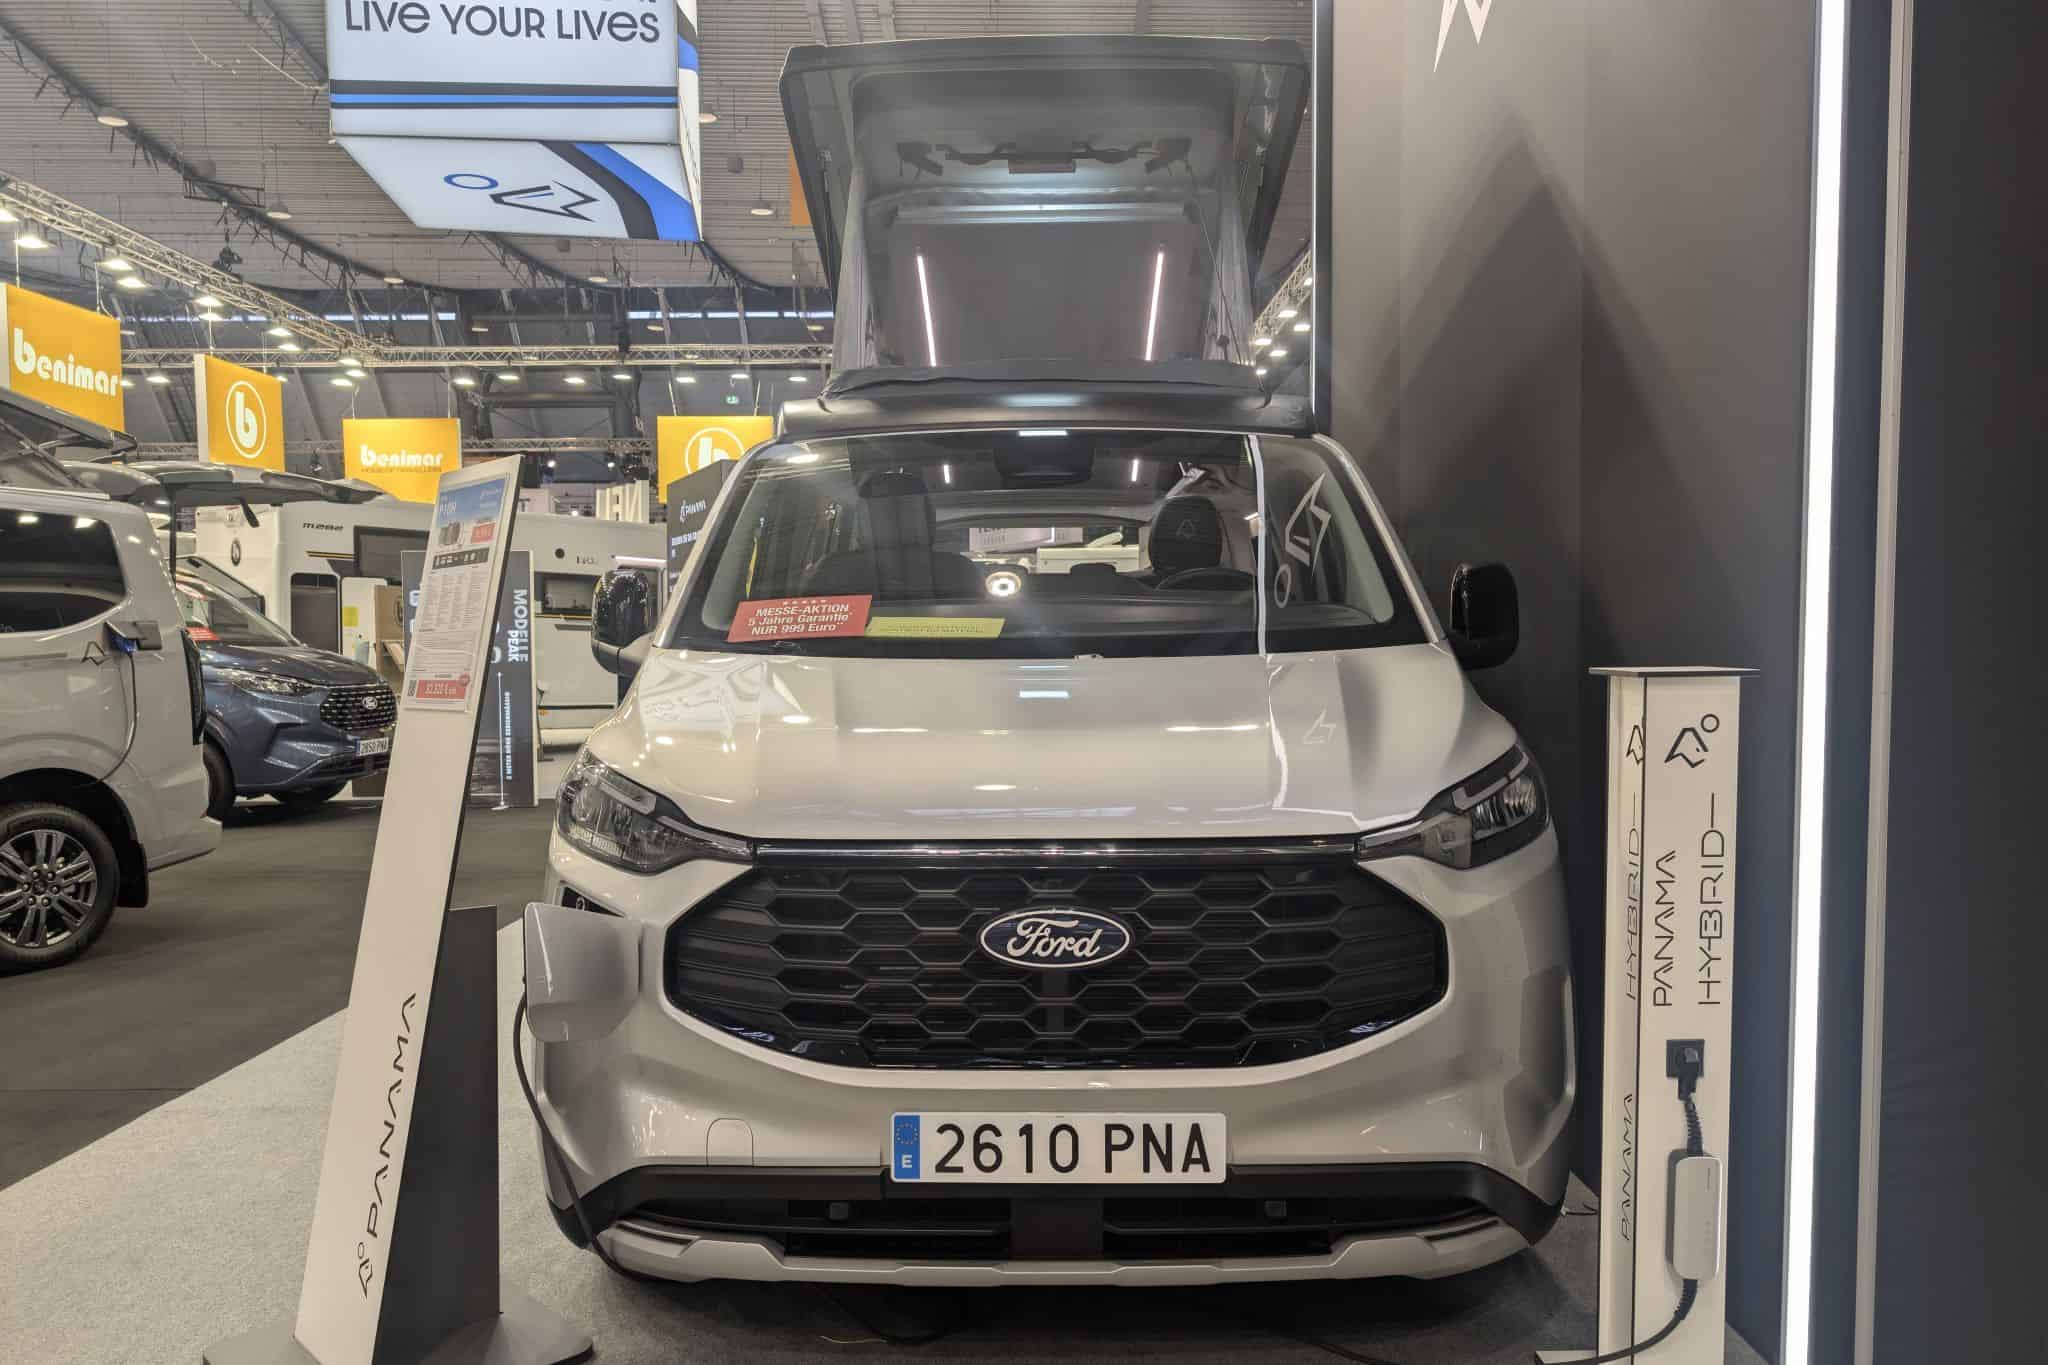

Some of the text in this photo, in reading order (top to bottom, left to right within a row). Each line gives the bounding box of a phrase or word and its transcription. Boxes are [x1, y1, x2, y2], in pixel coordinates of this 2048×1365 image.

[440, 4, 545, 38] YOUR
[14, 327, 119, 397] benimar
[360, 444, 444, 467] benimar
[513, 589, 529, 662] MODELLE
[748, 617, 755, 626] 5
[759, 613, 795, 625] Jahre
[751, 624, 778, 635] NUR
[781, 623, 804, 634] 999
[755, 603, 849, 616] MESSE-AKTION
[508, 630, 520, 662] PEAK
[1006, 917, 1103, 958] Ford
[1625, 828, 1640, 1000] HYBRID
[1652, 850, 1677, 1007] PANAMA
[1697, 829, 1725, 1005] HYBRID
[366, 993, 417, 1238] PANAMA
[901, 1122, 1211, 1173] E 2610 PNA
[1621, 1094, 1633, 1241] PANAMA
